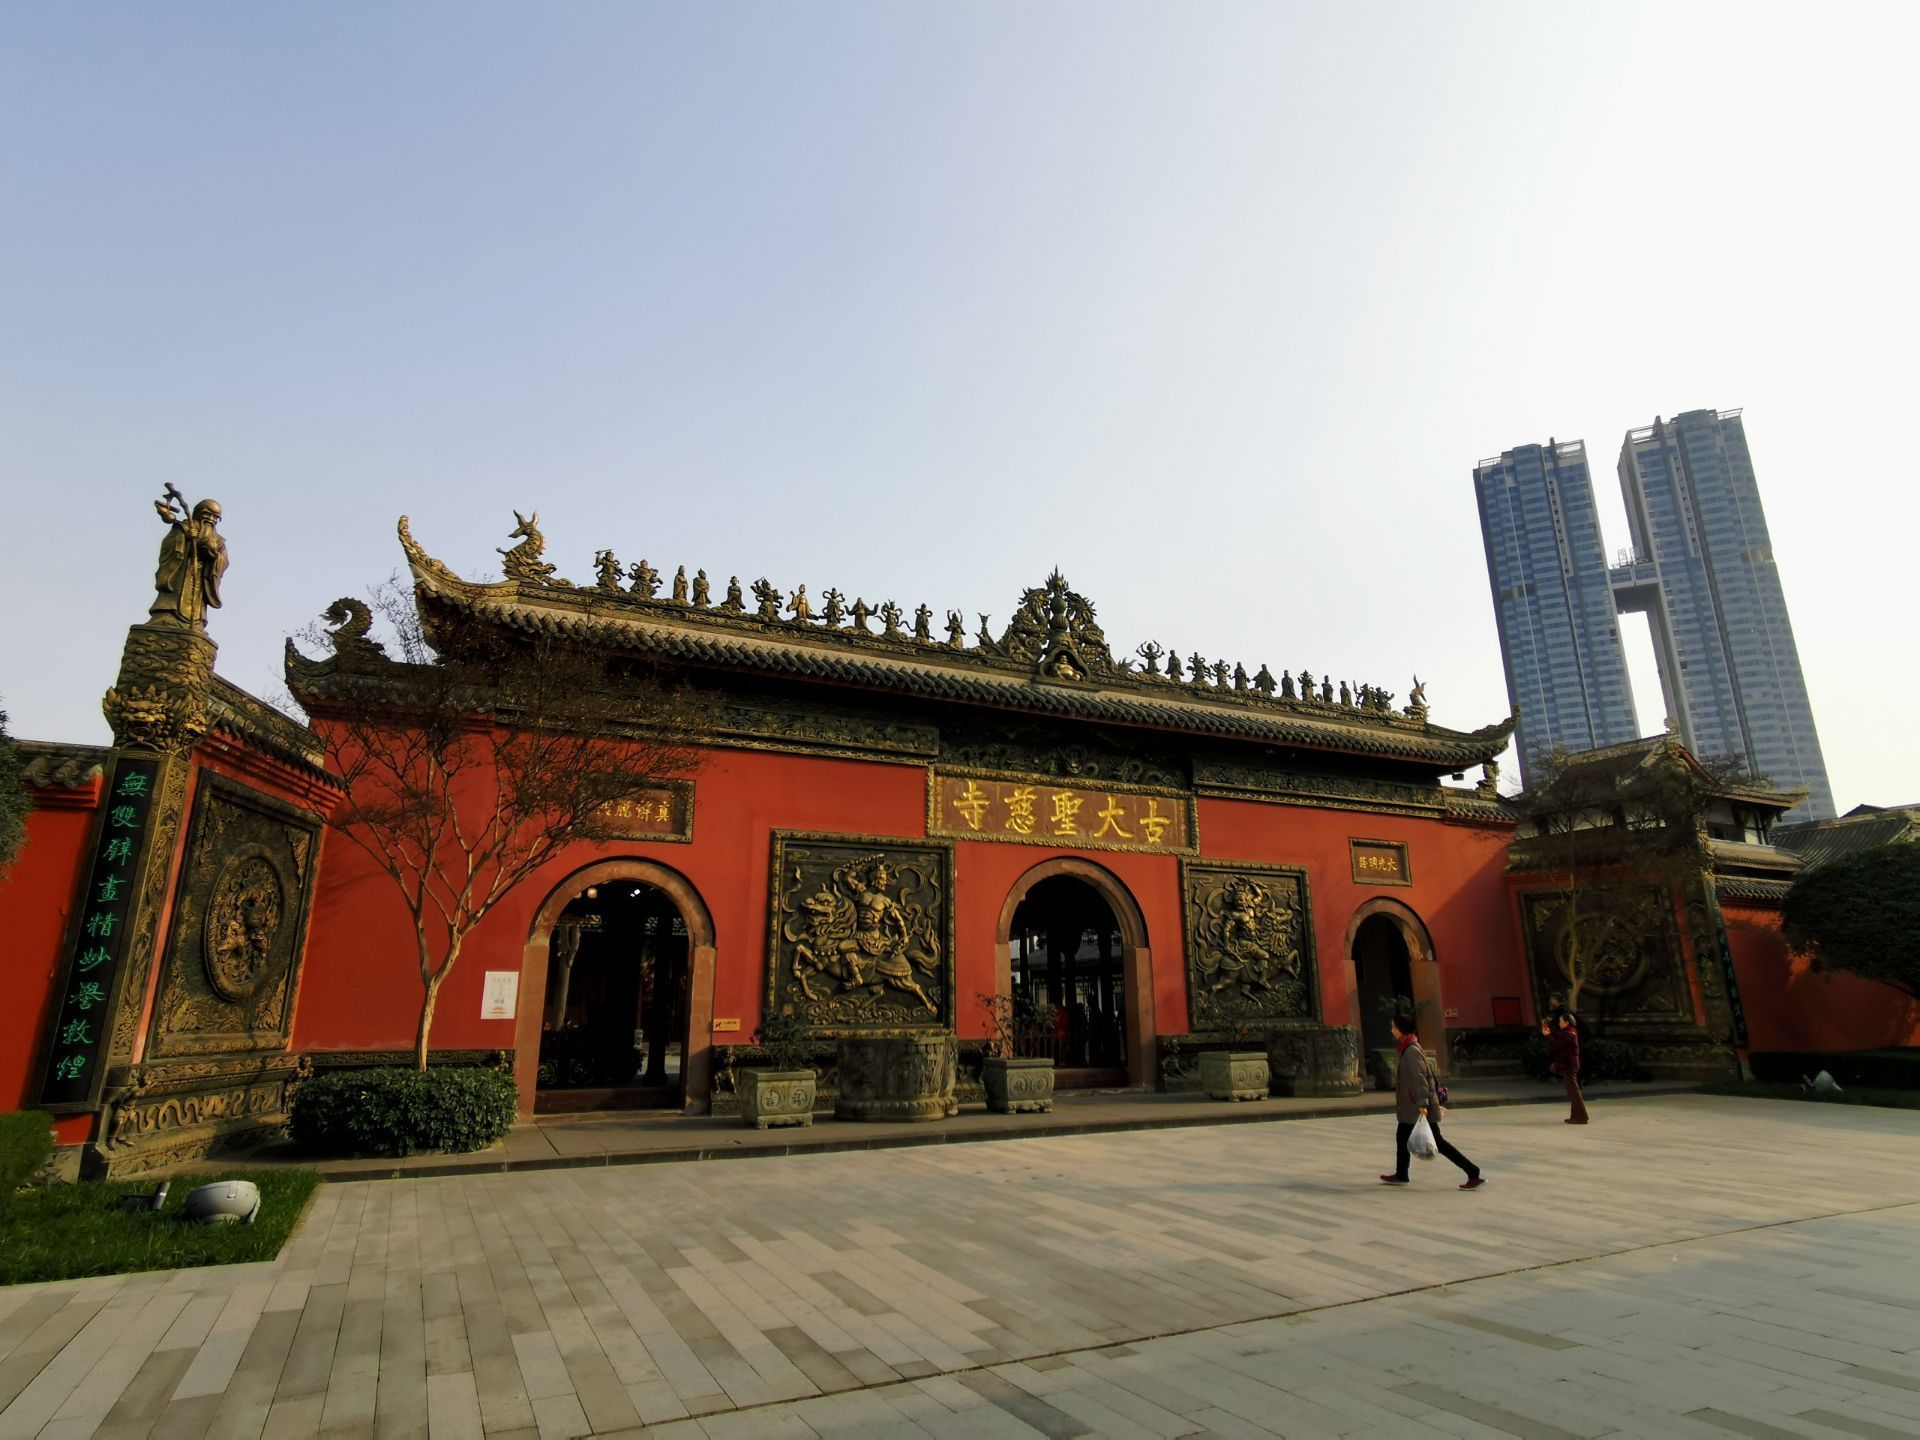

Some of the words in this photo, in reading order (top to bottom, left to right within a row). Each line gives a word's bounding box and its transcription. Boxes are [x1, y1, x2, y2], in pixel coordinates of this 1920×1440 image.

[953, 780, 1172, 843] 古大聖慈寺
